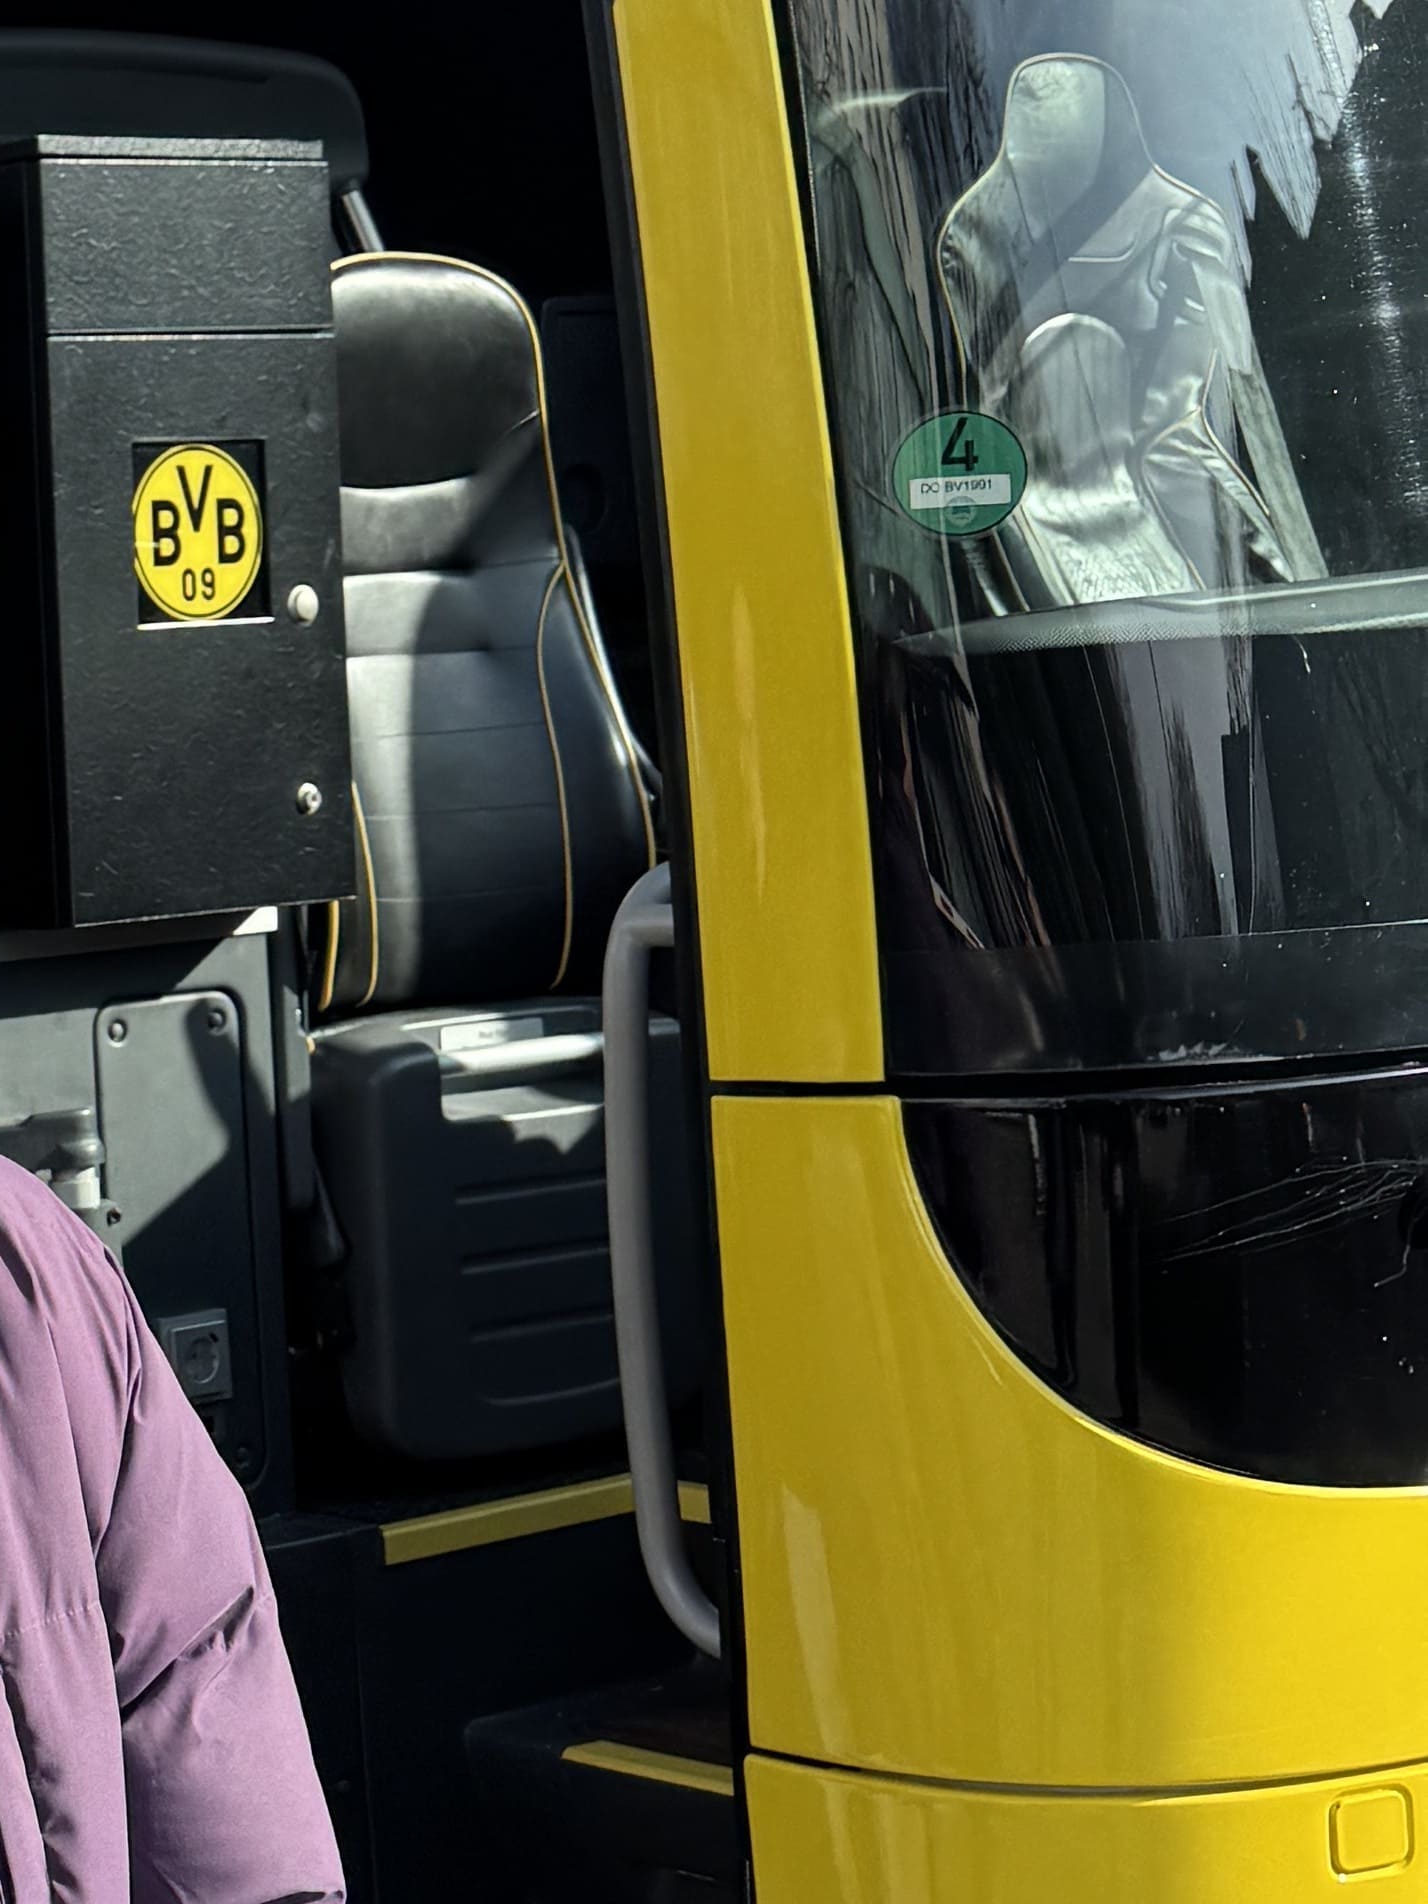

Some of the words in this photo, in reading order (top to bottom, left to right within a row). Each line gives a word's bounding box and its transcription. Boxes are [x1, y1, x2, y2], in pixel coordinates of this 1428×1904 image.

[941, 416, 979, 472] 4
[152, 464, 246, 567] BVB
[182, 568, 216, 602] 09
